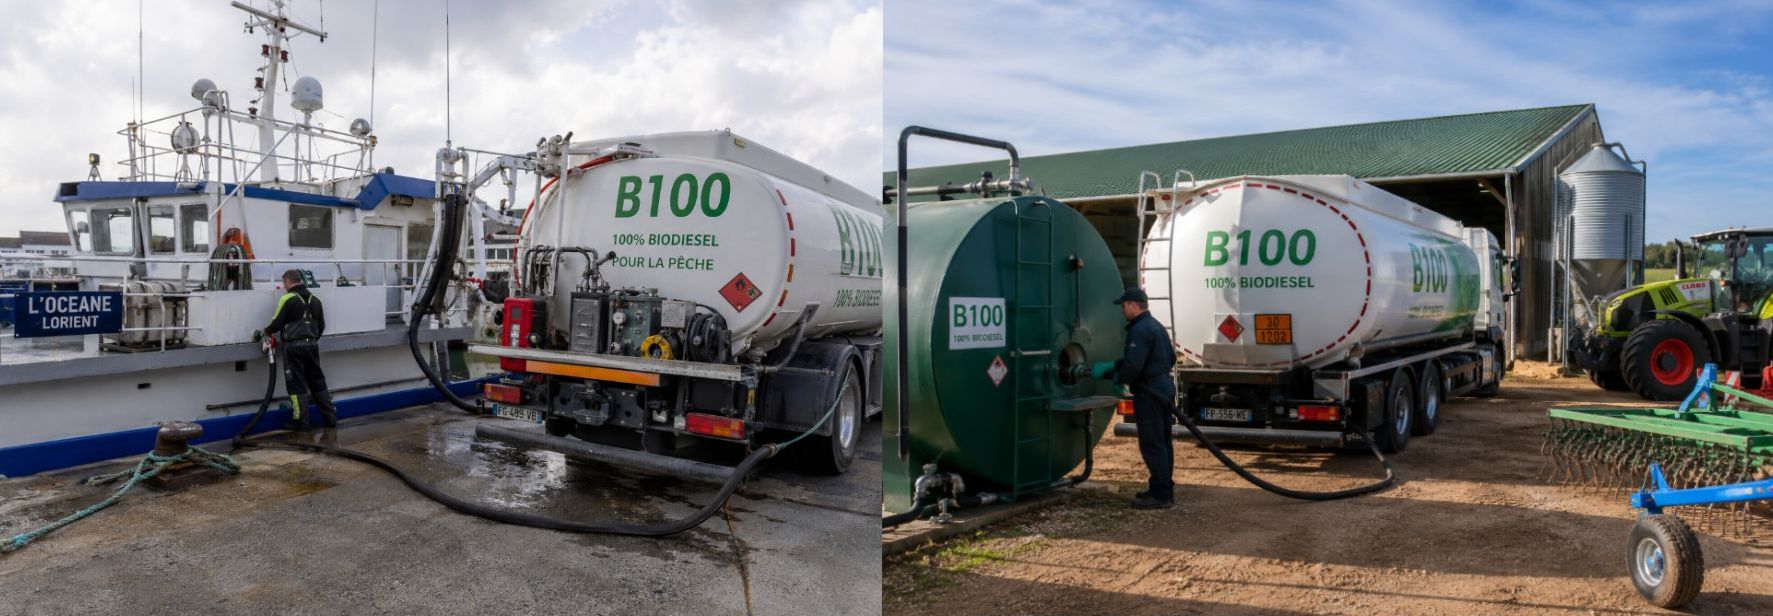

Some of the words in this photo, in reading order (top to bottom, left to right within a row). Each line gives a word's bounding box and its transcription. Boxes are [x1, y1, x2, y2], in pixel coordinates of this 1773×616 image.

[615, 172, 731, 218] B100
[613, 234, 645, 245] 100%
[648, 233, 719, 247] BIODIESEL
[1204, 229, 1316, 266] B100
[612, 256, 645, 268] POUR
[648, 257, 664, 269] LA
[668, 255, 714, 271] PÊCHE
[1408, 243, 1447, 293] B100
[1205, 277, 1236, 289] 100%
[1240, 276, 1315, 289] BIODIESEL
[42, 315, 99, 329] LORIENT
[953, 304, 1003, 327] B100
[1266, 316, 1281, 327] 30
[1261, 331, 1287, 342] 1202
